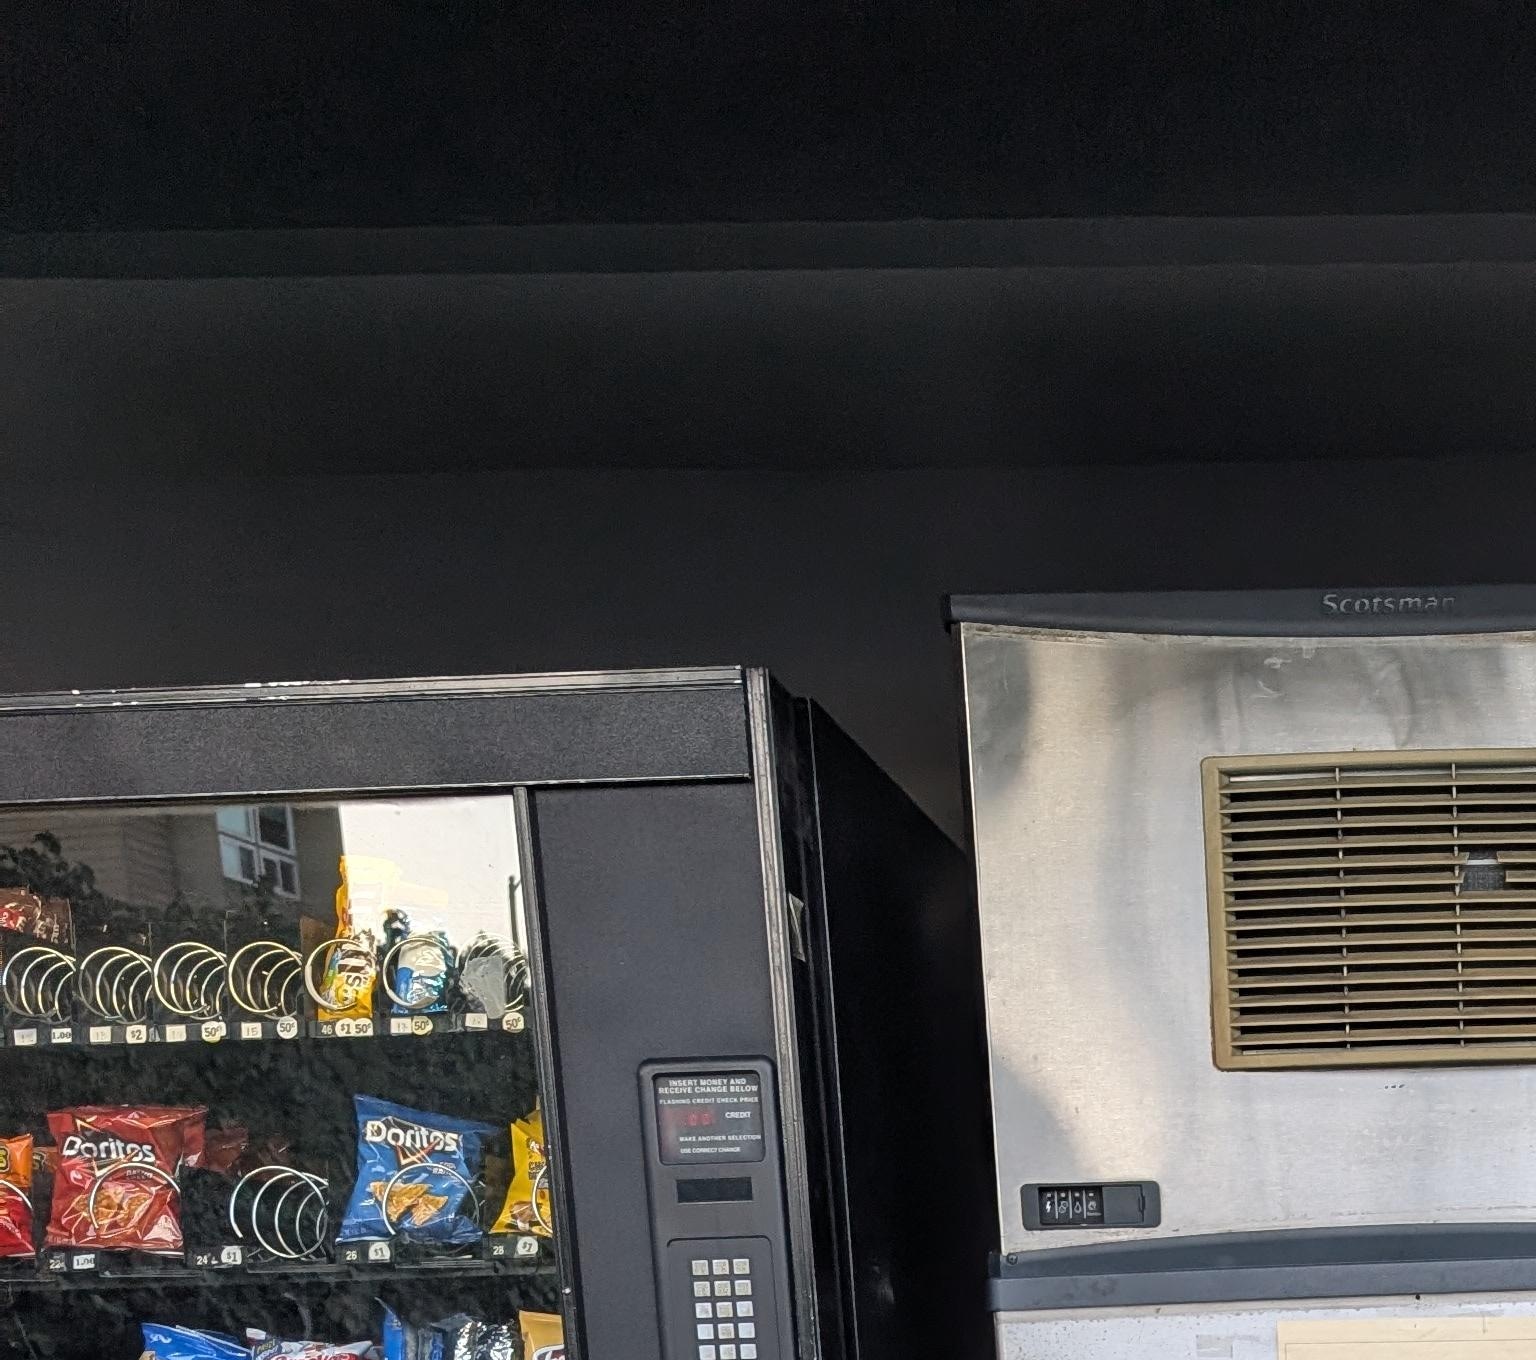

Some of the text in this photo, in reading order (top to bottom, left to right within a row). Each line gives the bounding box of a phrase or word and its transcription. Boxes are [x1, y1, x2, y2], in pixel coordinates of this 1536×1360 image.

[1321, 593, 1456, 614] Scotsman
[130, 1028, 144, 1041] $2
[321, 1026, 333, 1035] 46
[668, 1078, 747, 1087] INSERT MONEY AND
[658, 1085, 758, 1095] RECEIVE CHANGE BELOW
[725, 1111, 752, 1119] CREDIT
[365, 1120, 459, 1152] Doritos
[62, 1135, 156, 1163] Doritos
[345, 1251, 358, 1261] 26
[492, 1246, 505, 1256] 28
[197, 1256, 209, 1266] 24
